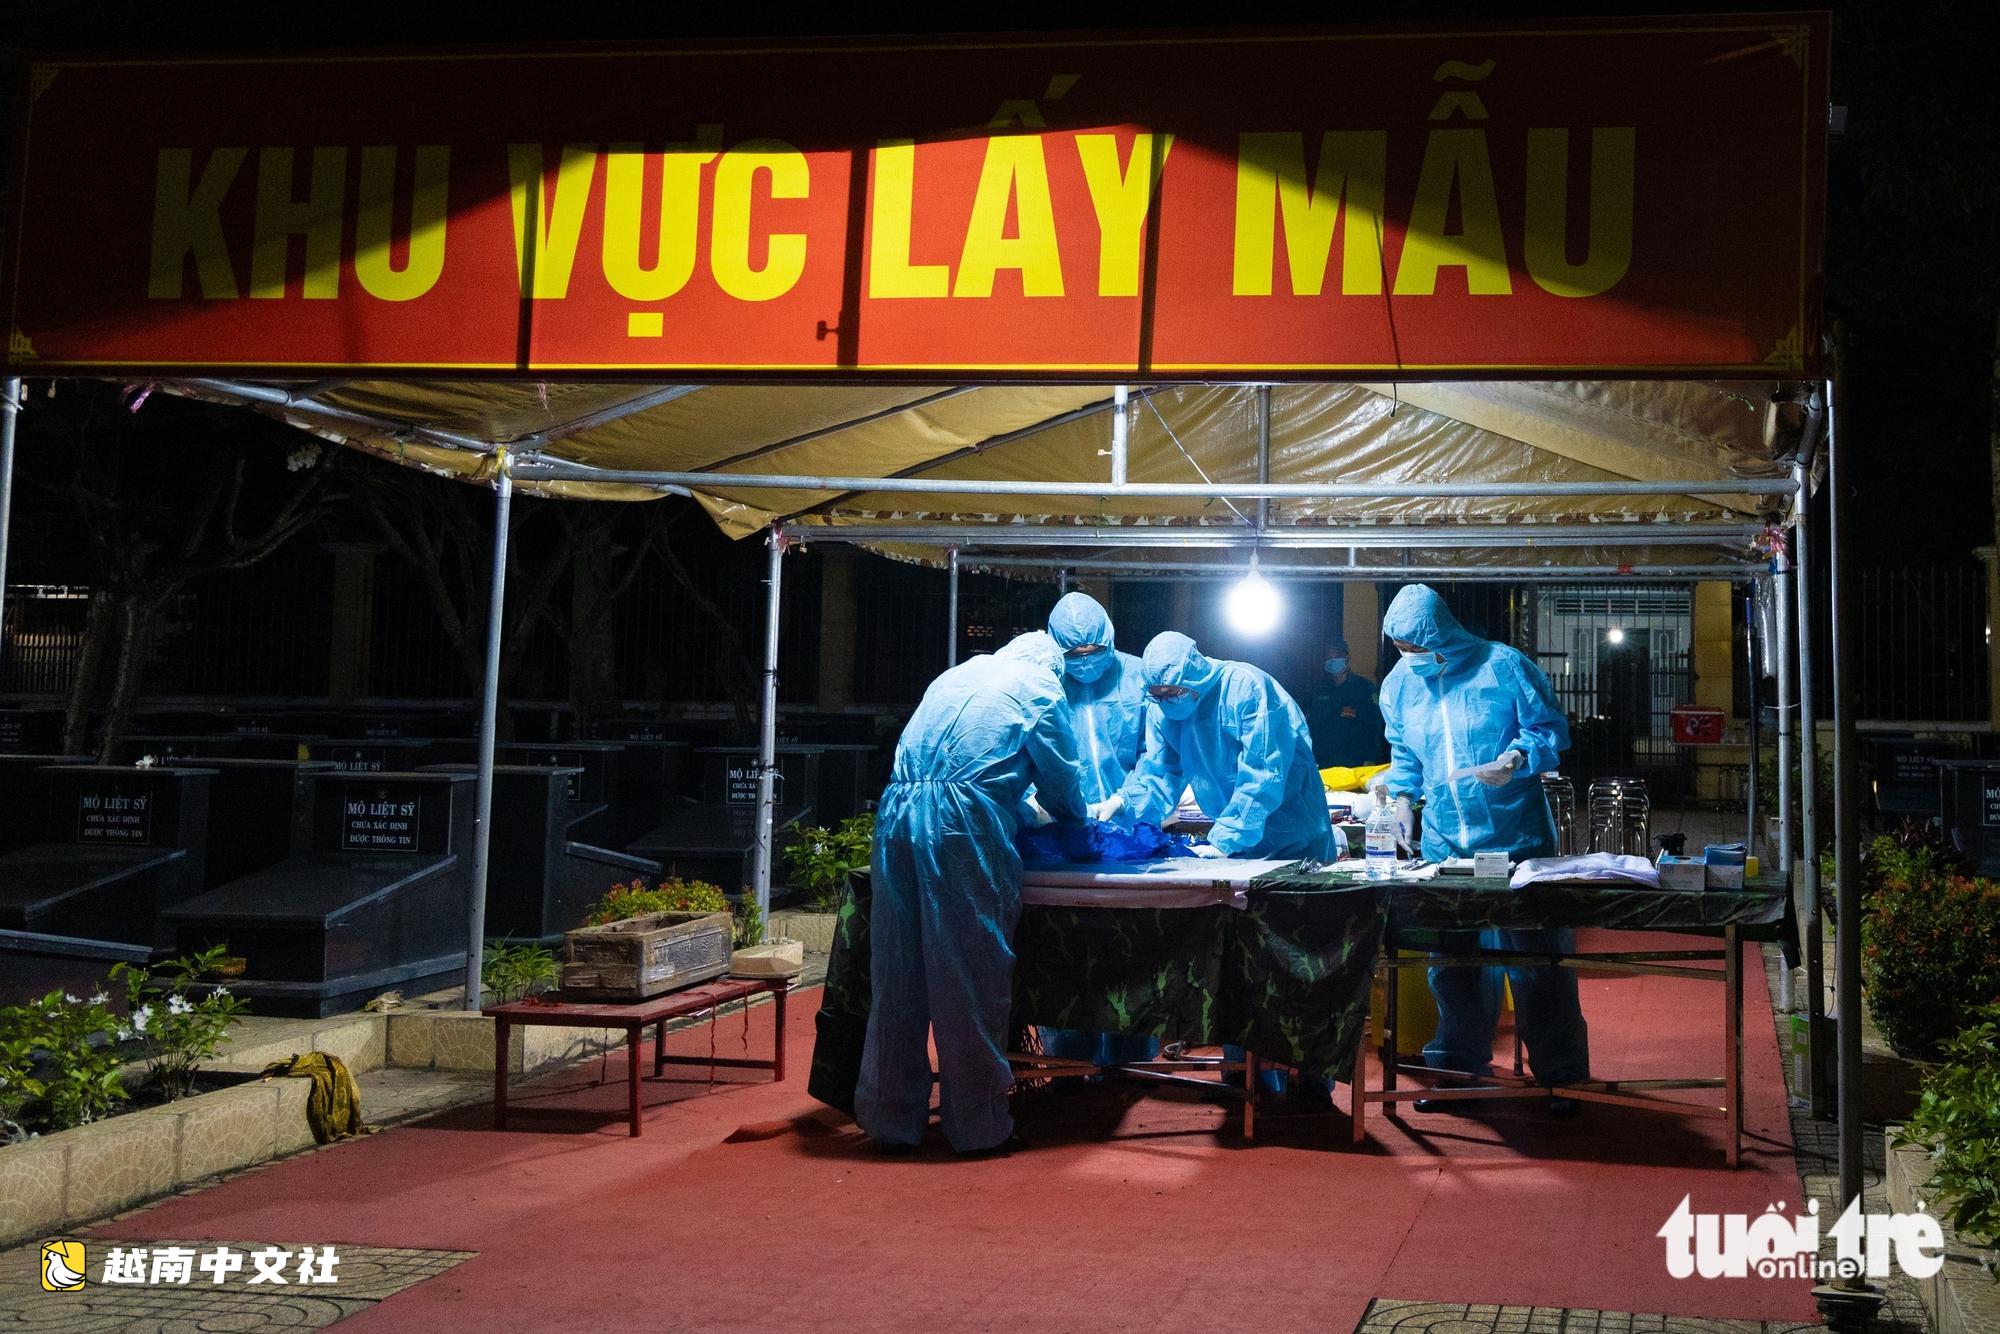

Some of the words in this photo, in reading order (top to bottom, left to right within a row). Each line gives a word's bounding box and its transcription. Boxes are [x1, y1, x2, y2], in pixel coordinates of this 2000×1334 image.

[147, 144, 452, 303] KHU
[507, 124, 811, 338] VỰC
[867, 73, 1176, 299] LẤY
[1231, 58, 1637, 299] MẪU
